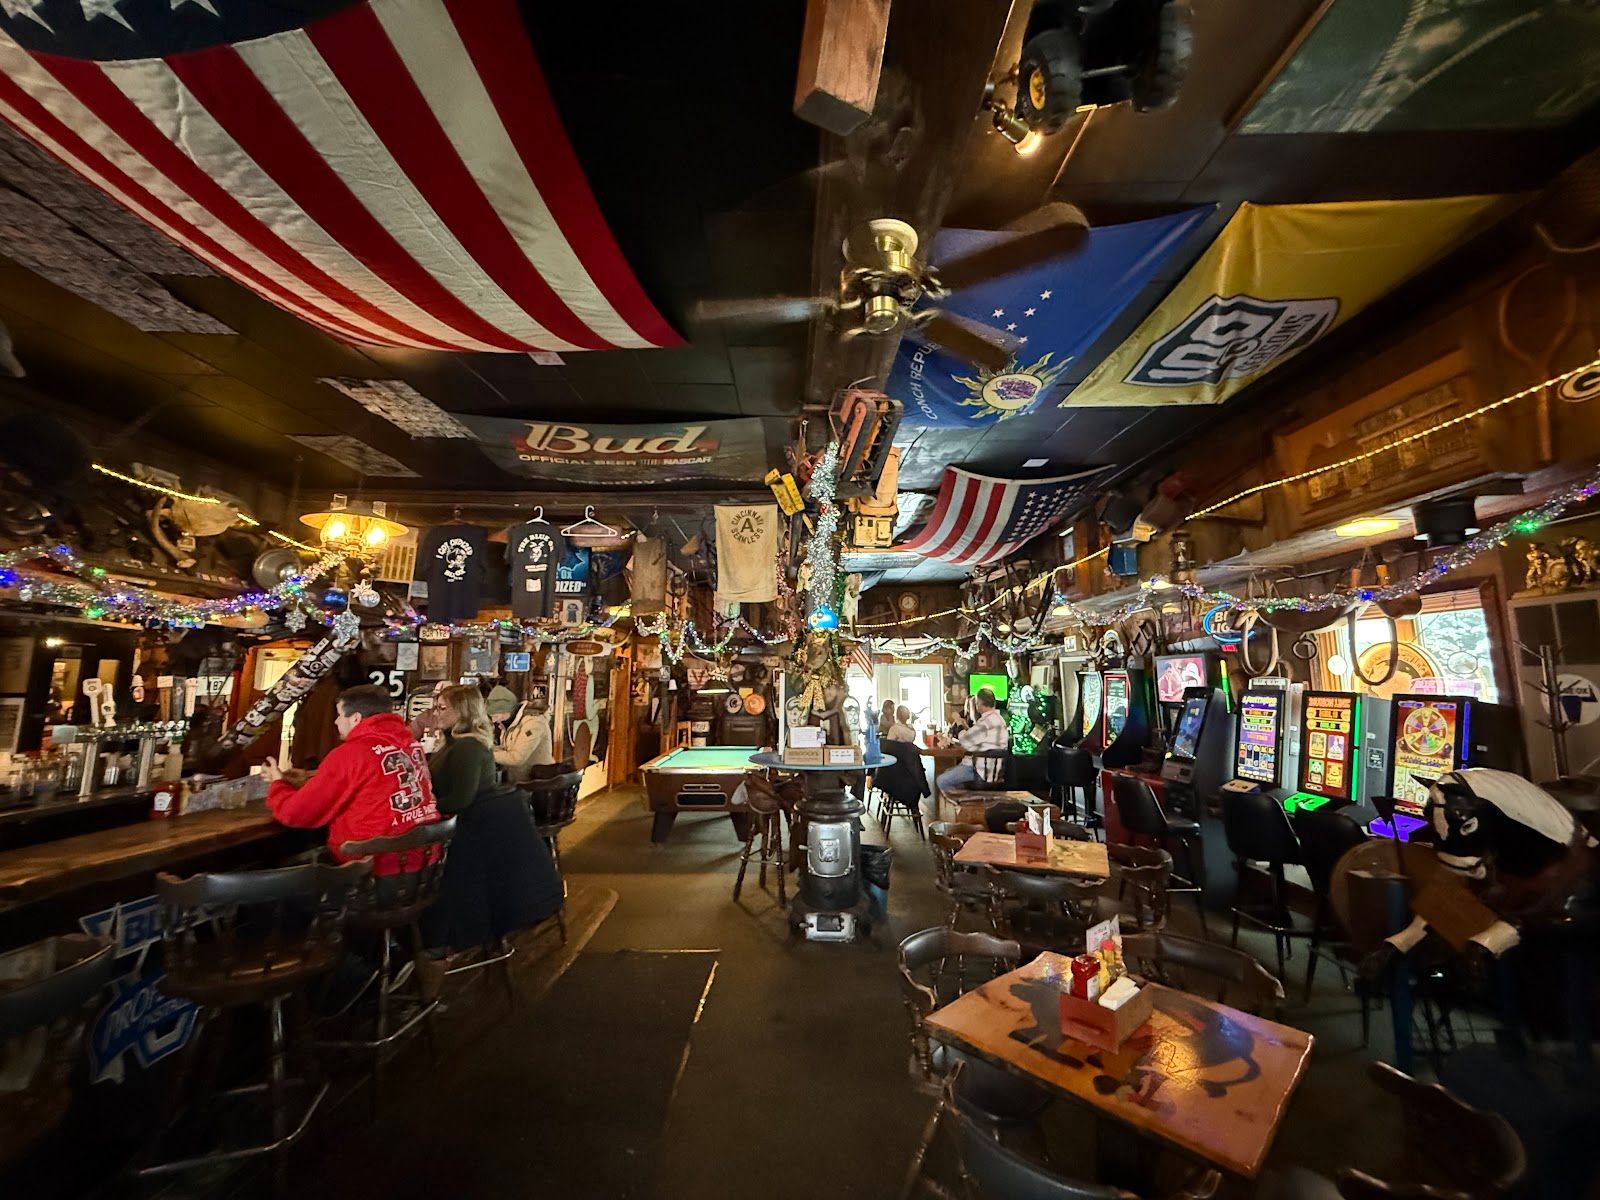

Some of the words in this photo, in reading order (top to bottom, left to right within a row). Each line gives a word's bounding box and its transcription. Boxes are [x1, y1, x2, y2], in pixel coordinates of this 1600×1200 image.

[1234, 312, 1317, 371] SEASONS
[910, 381, 938, 431] CONCH
[524, 423, 707, 454] Bud
[519, 454, 588, 466] OFFICIAL
[662, 456, 712, 465] NASCAR
[731, 509, 764, 526] CINCINNATI
[740, 517, 754, 532] A
[518, 537, 530, 552] THE
[529, 533, 551, 541] BLUE
[731, 528, 764, 544] SEAMLESS
[401, 812, 424, 823] TRUE
